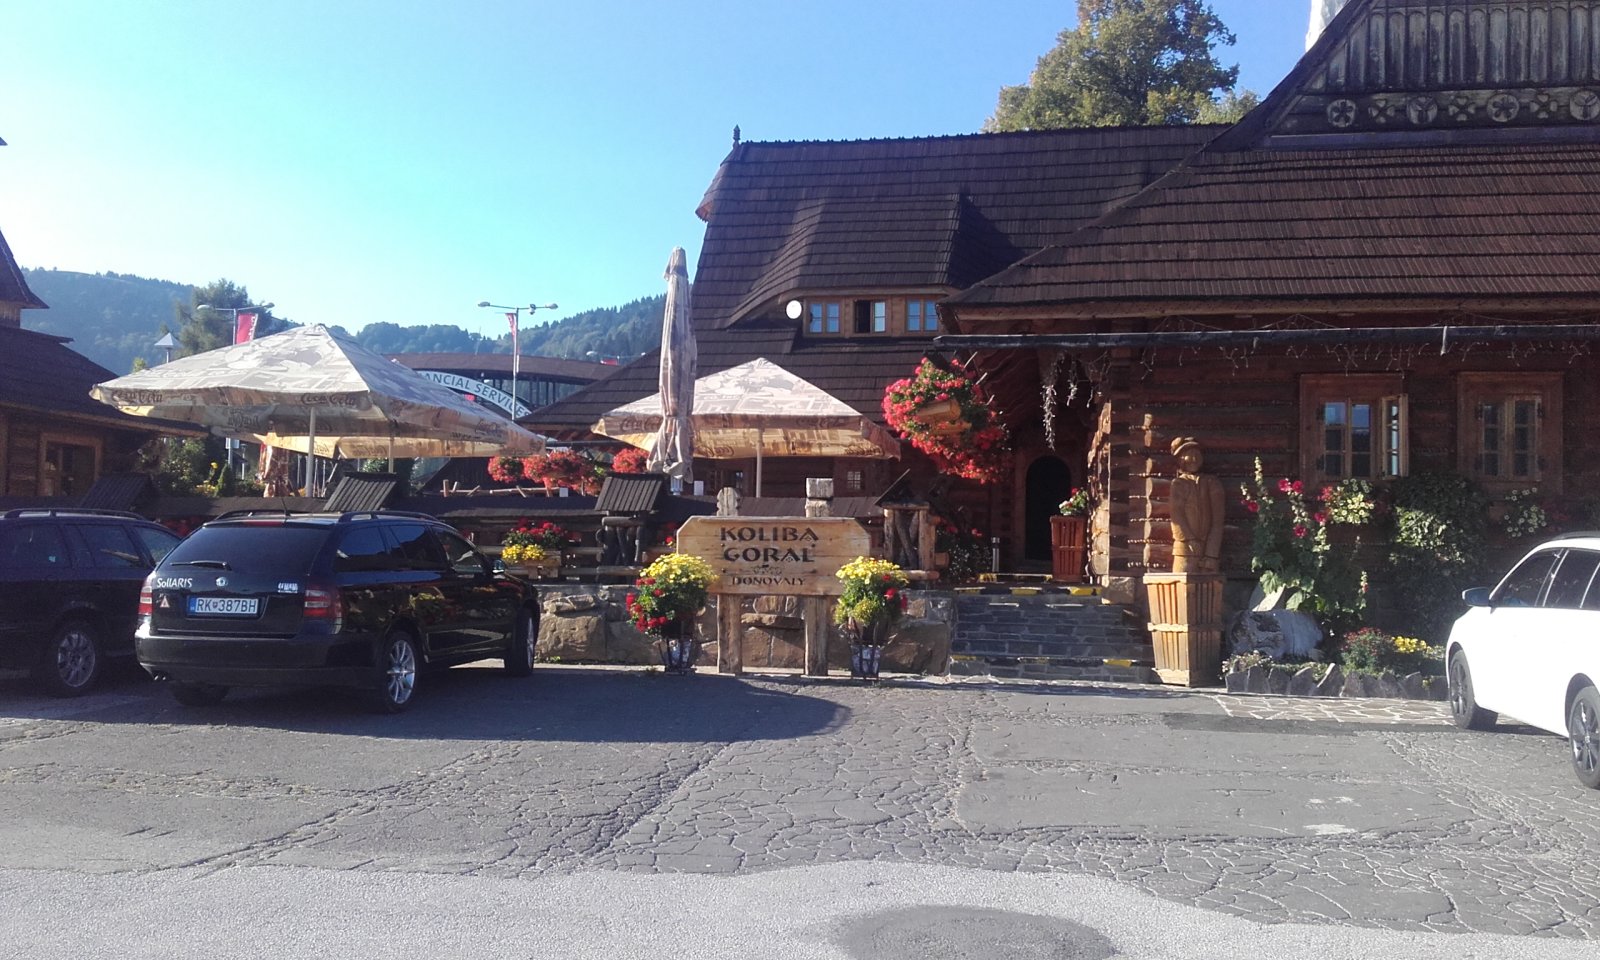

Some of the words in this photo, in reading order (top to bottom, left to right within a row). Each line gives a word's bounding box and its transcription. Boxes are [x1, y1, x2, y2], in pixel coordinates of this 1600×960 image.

[720, 526, 819, 542] KOLIBA
[723, 547, 814, 562] GORAL
[732, 576, 806, 586] DONOVALY
